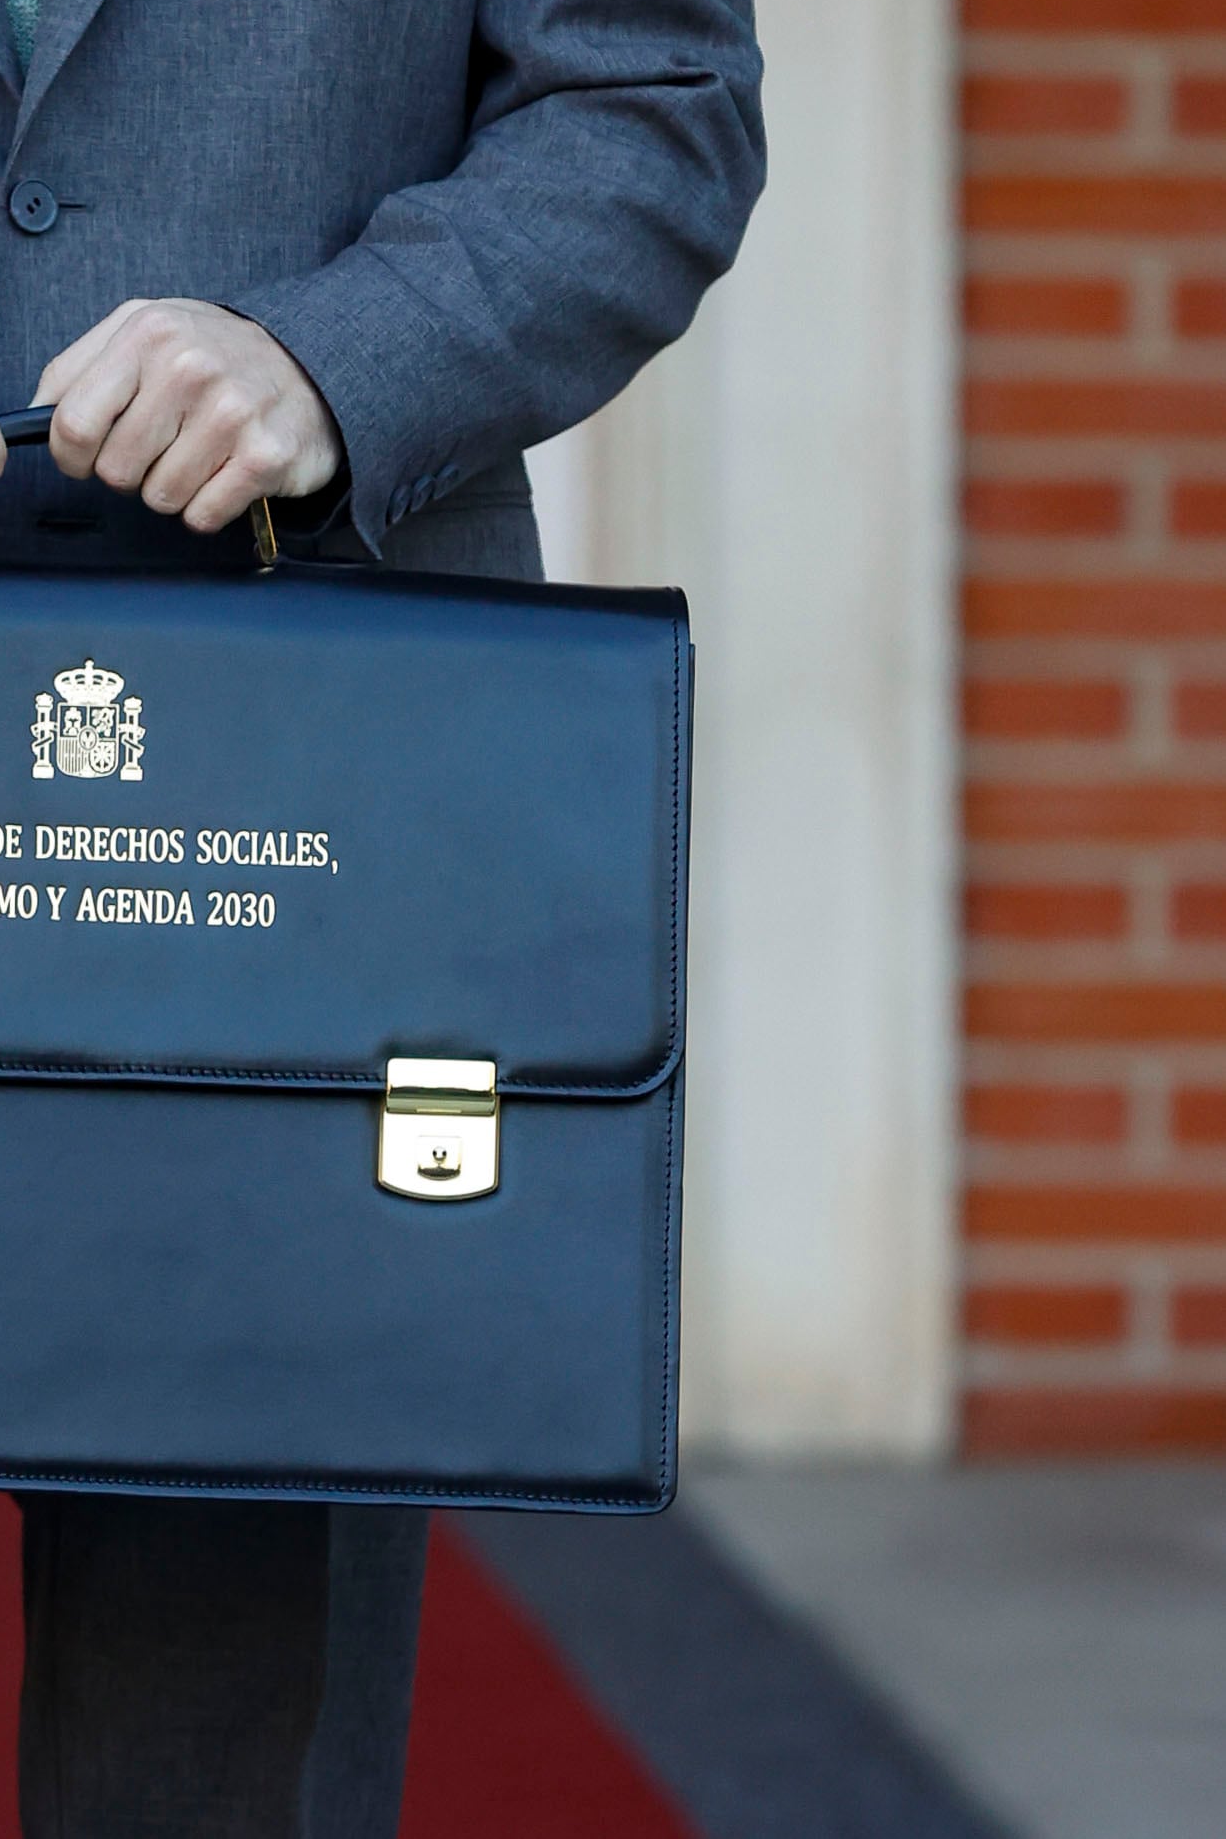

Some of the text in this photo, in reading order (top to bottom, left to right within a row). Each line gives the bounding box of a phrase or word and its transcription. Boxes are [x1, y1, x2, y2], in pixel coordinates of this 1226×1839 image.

[35, 825, 185, 864] DERECHOS
[196, 829, 339, 875] SOCIALES,
[45, 886, 68, 921] Y
[75, 887, 195, 925] AGENDA
[206, 891, 276, 928] 2030
